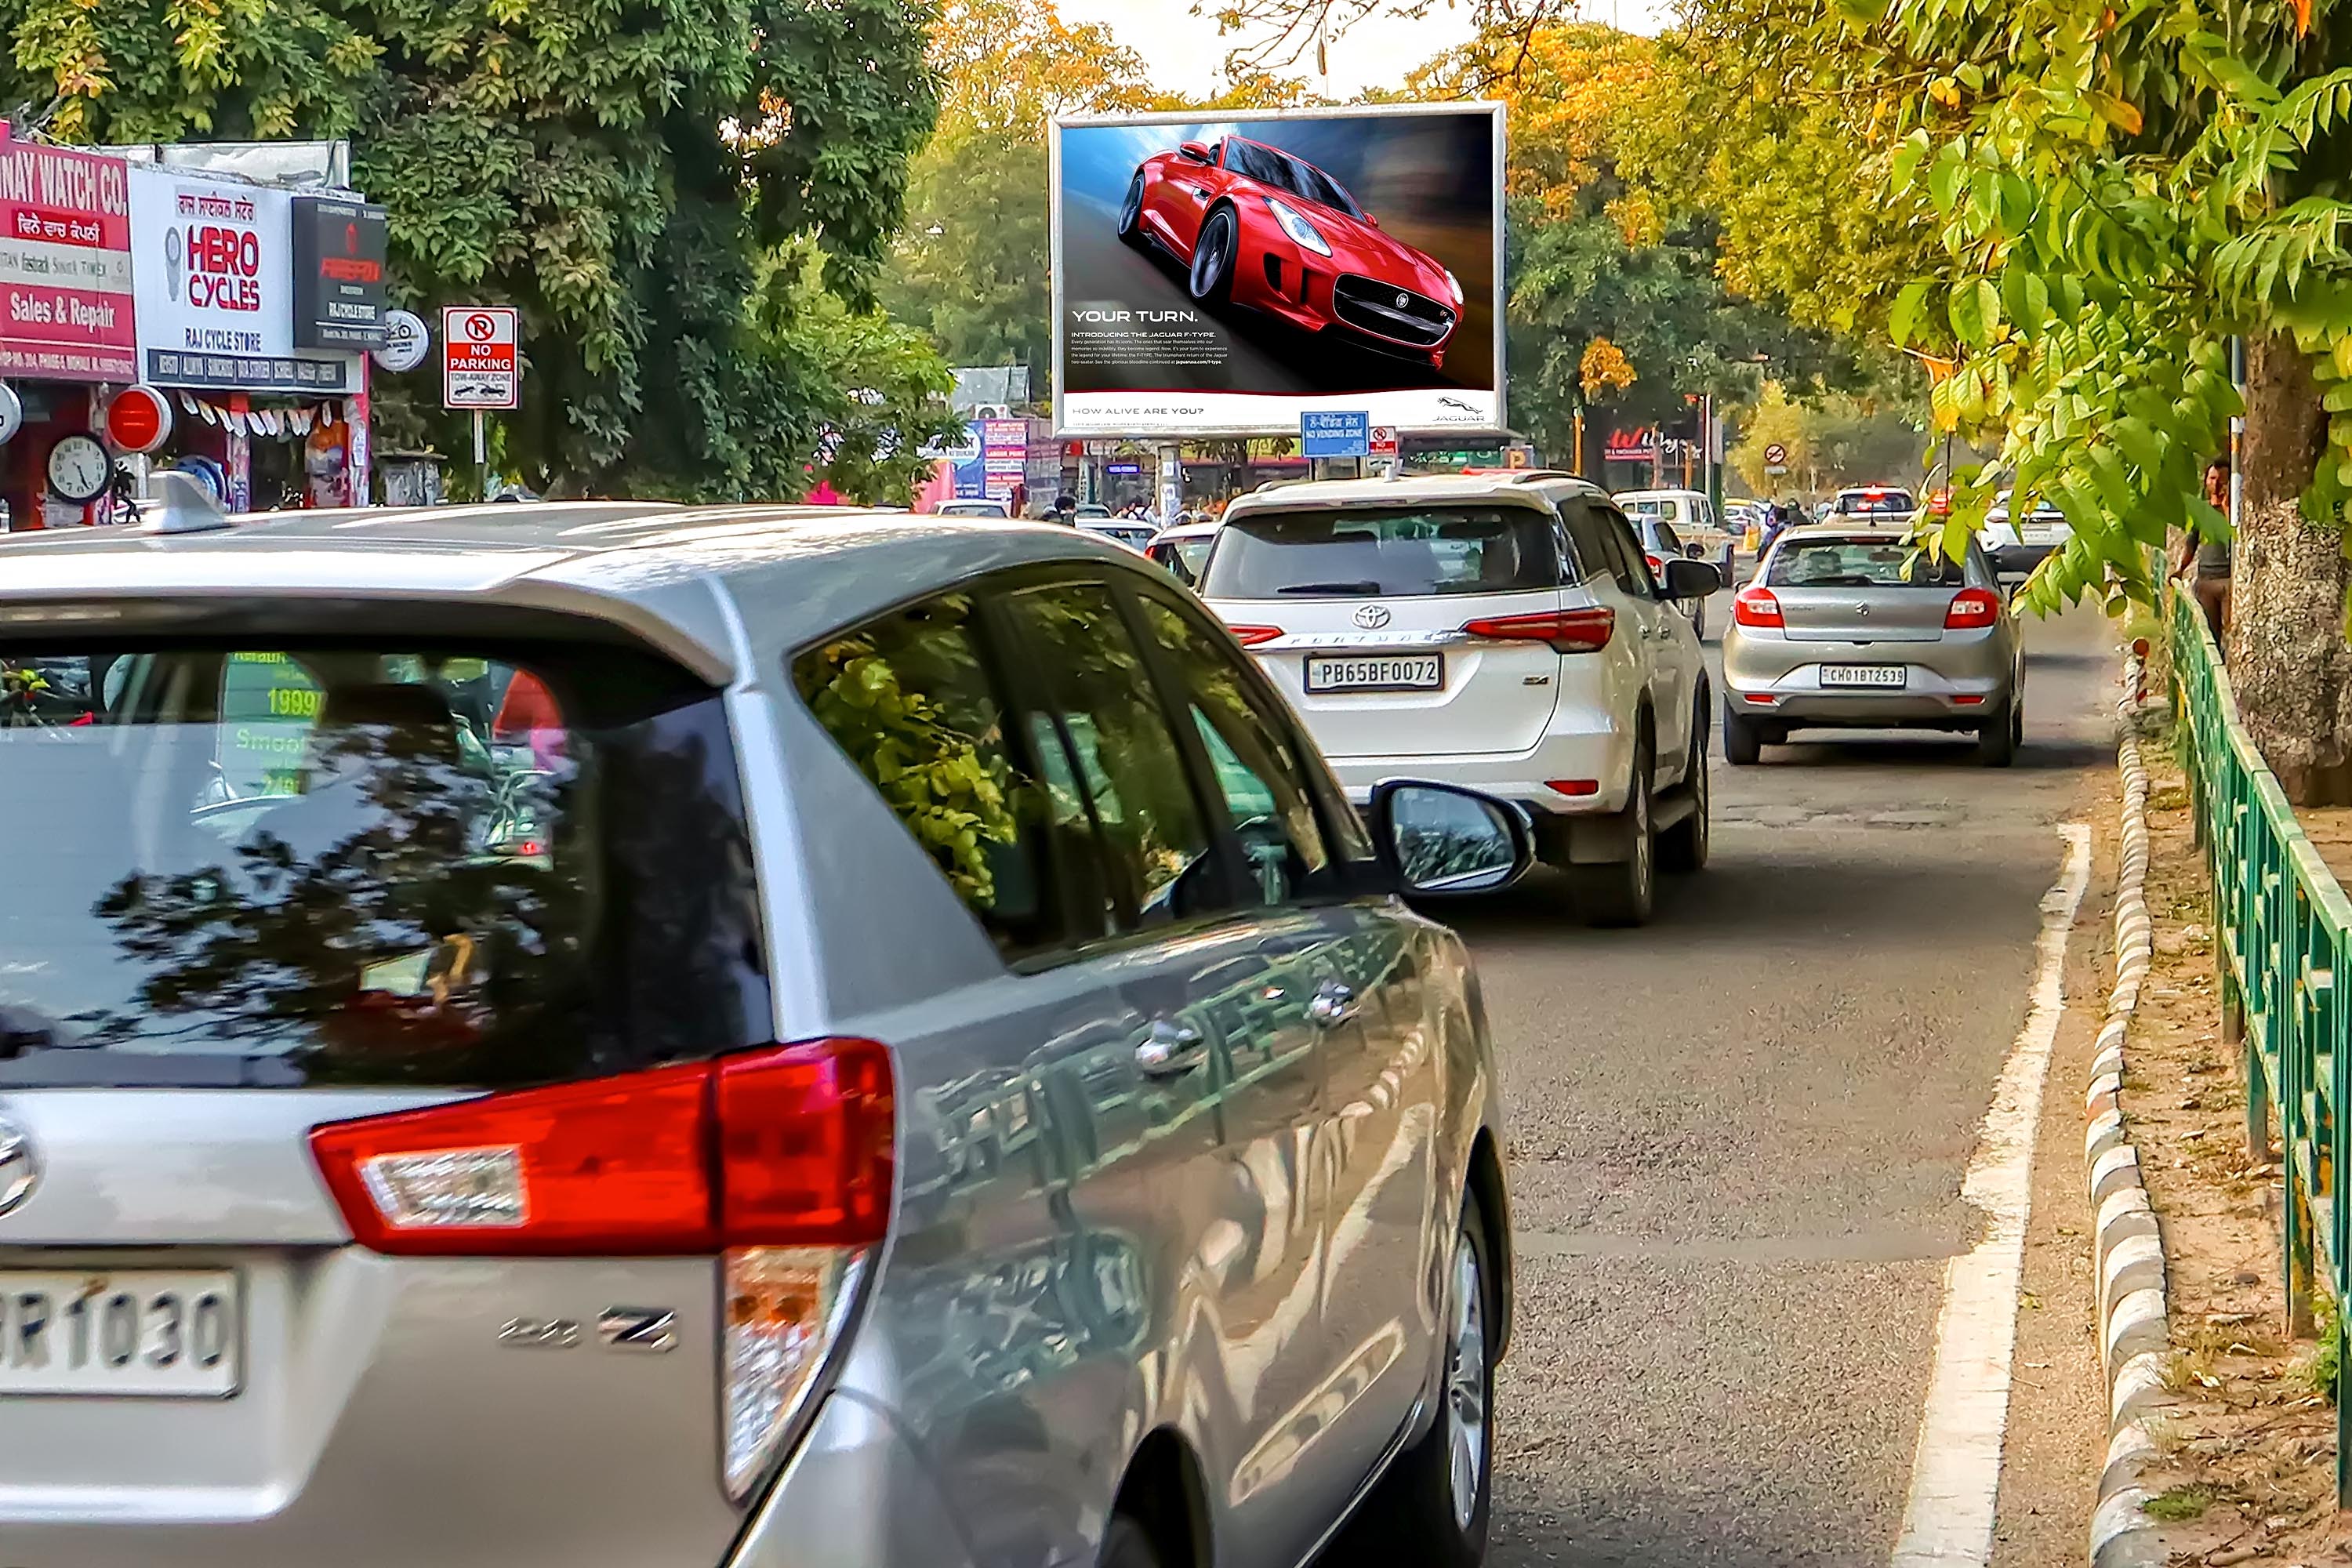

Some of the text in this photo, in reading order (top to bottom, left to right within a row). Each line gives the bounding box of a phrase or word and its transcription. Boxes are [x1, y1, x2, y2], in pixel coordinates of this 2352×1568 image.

[40, 154, 98, 212] WATCH
[100, 163, 129, 217] CO.
[187, 224, 260, 278] HERO
[188, 274, 260, 311] CYCLES
[10, 291, 116, 334] Sales & Repair
[1072, 310, 1199, 322] YOUR TURN.
[185, 328, 261, 352] RAJ CYCLE STORE
[470, 344, 492, 356] NO
[450, 358, 512, 370] PARKING
[450, 372, 511, 383] TOW-AWAY ZONE
[1305, 428, 1363, 438] NO VENDING ZONE
[1322, 662, 1436, 684] PB65BF0072
[1831, 670, 1904, 683] CH01BT2539
[0, 1292, 227, 1370] R1030
